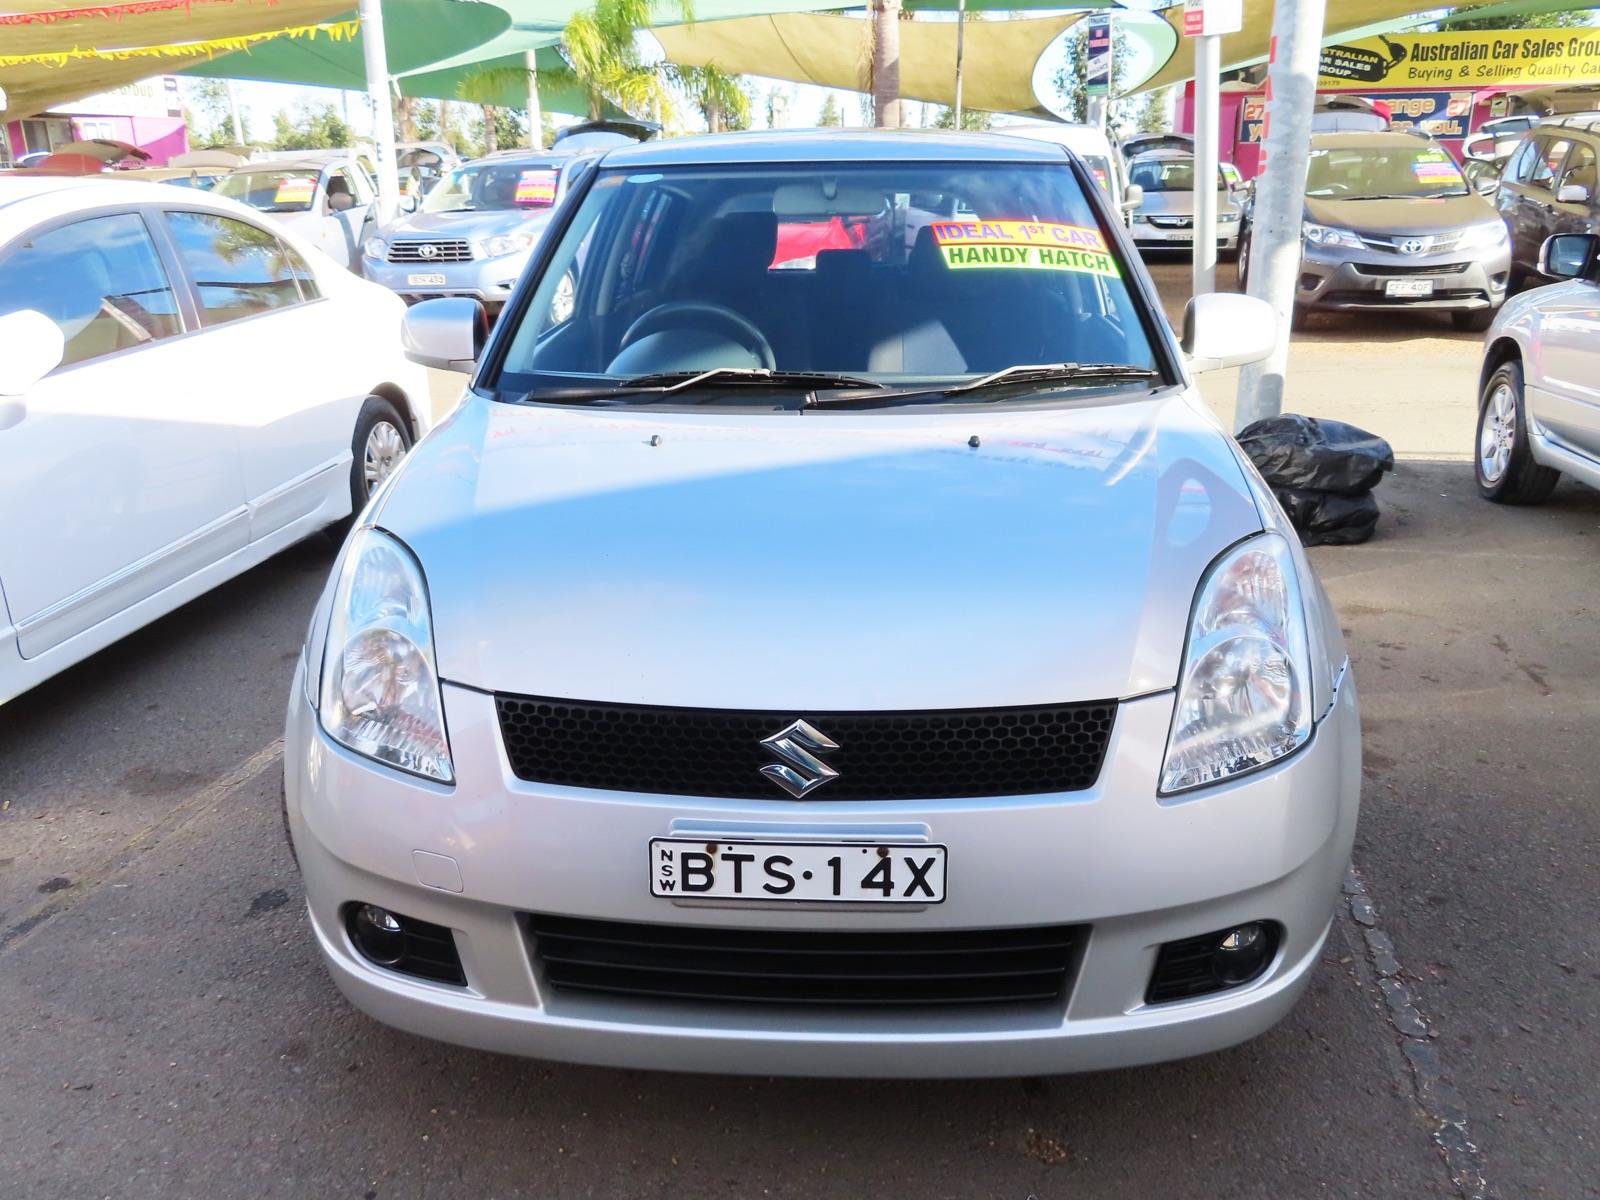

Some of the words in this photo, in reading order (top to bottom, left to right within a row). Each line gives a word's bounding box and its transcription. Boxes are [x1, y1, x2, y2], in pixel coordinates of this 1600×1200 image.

[1410, 42, 1489, 62] Australian
[1492, 39, 1519, 60] Car
[1521, 38, 1564, 59] Sales
[1335, 58, 1371, 72] SALES
[1408, 66, 1453, 82] Buying
[1458, 65, 1470, 78] &
[1476, 64, 1522, 79] Selling
[1527, 63, 1576, 79] Quality
[936, 223, 1013, 240] IDEAL
[1050, 227, 1102, 248] CAR
[950, 247, 1029, 264] HANDY
[1039, 250, 1111, 272] HATCH
